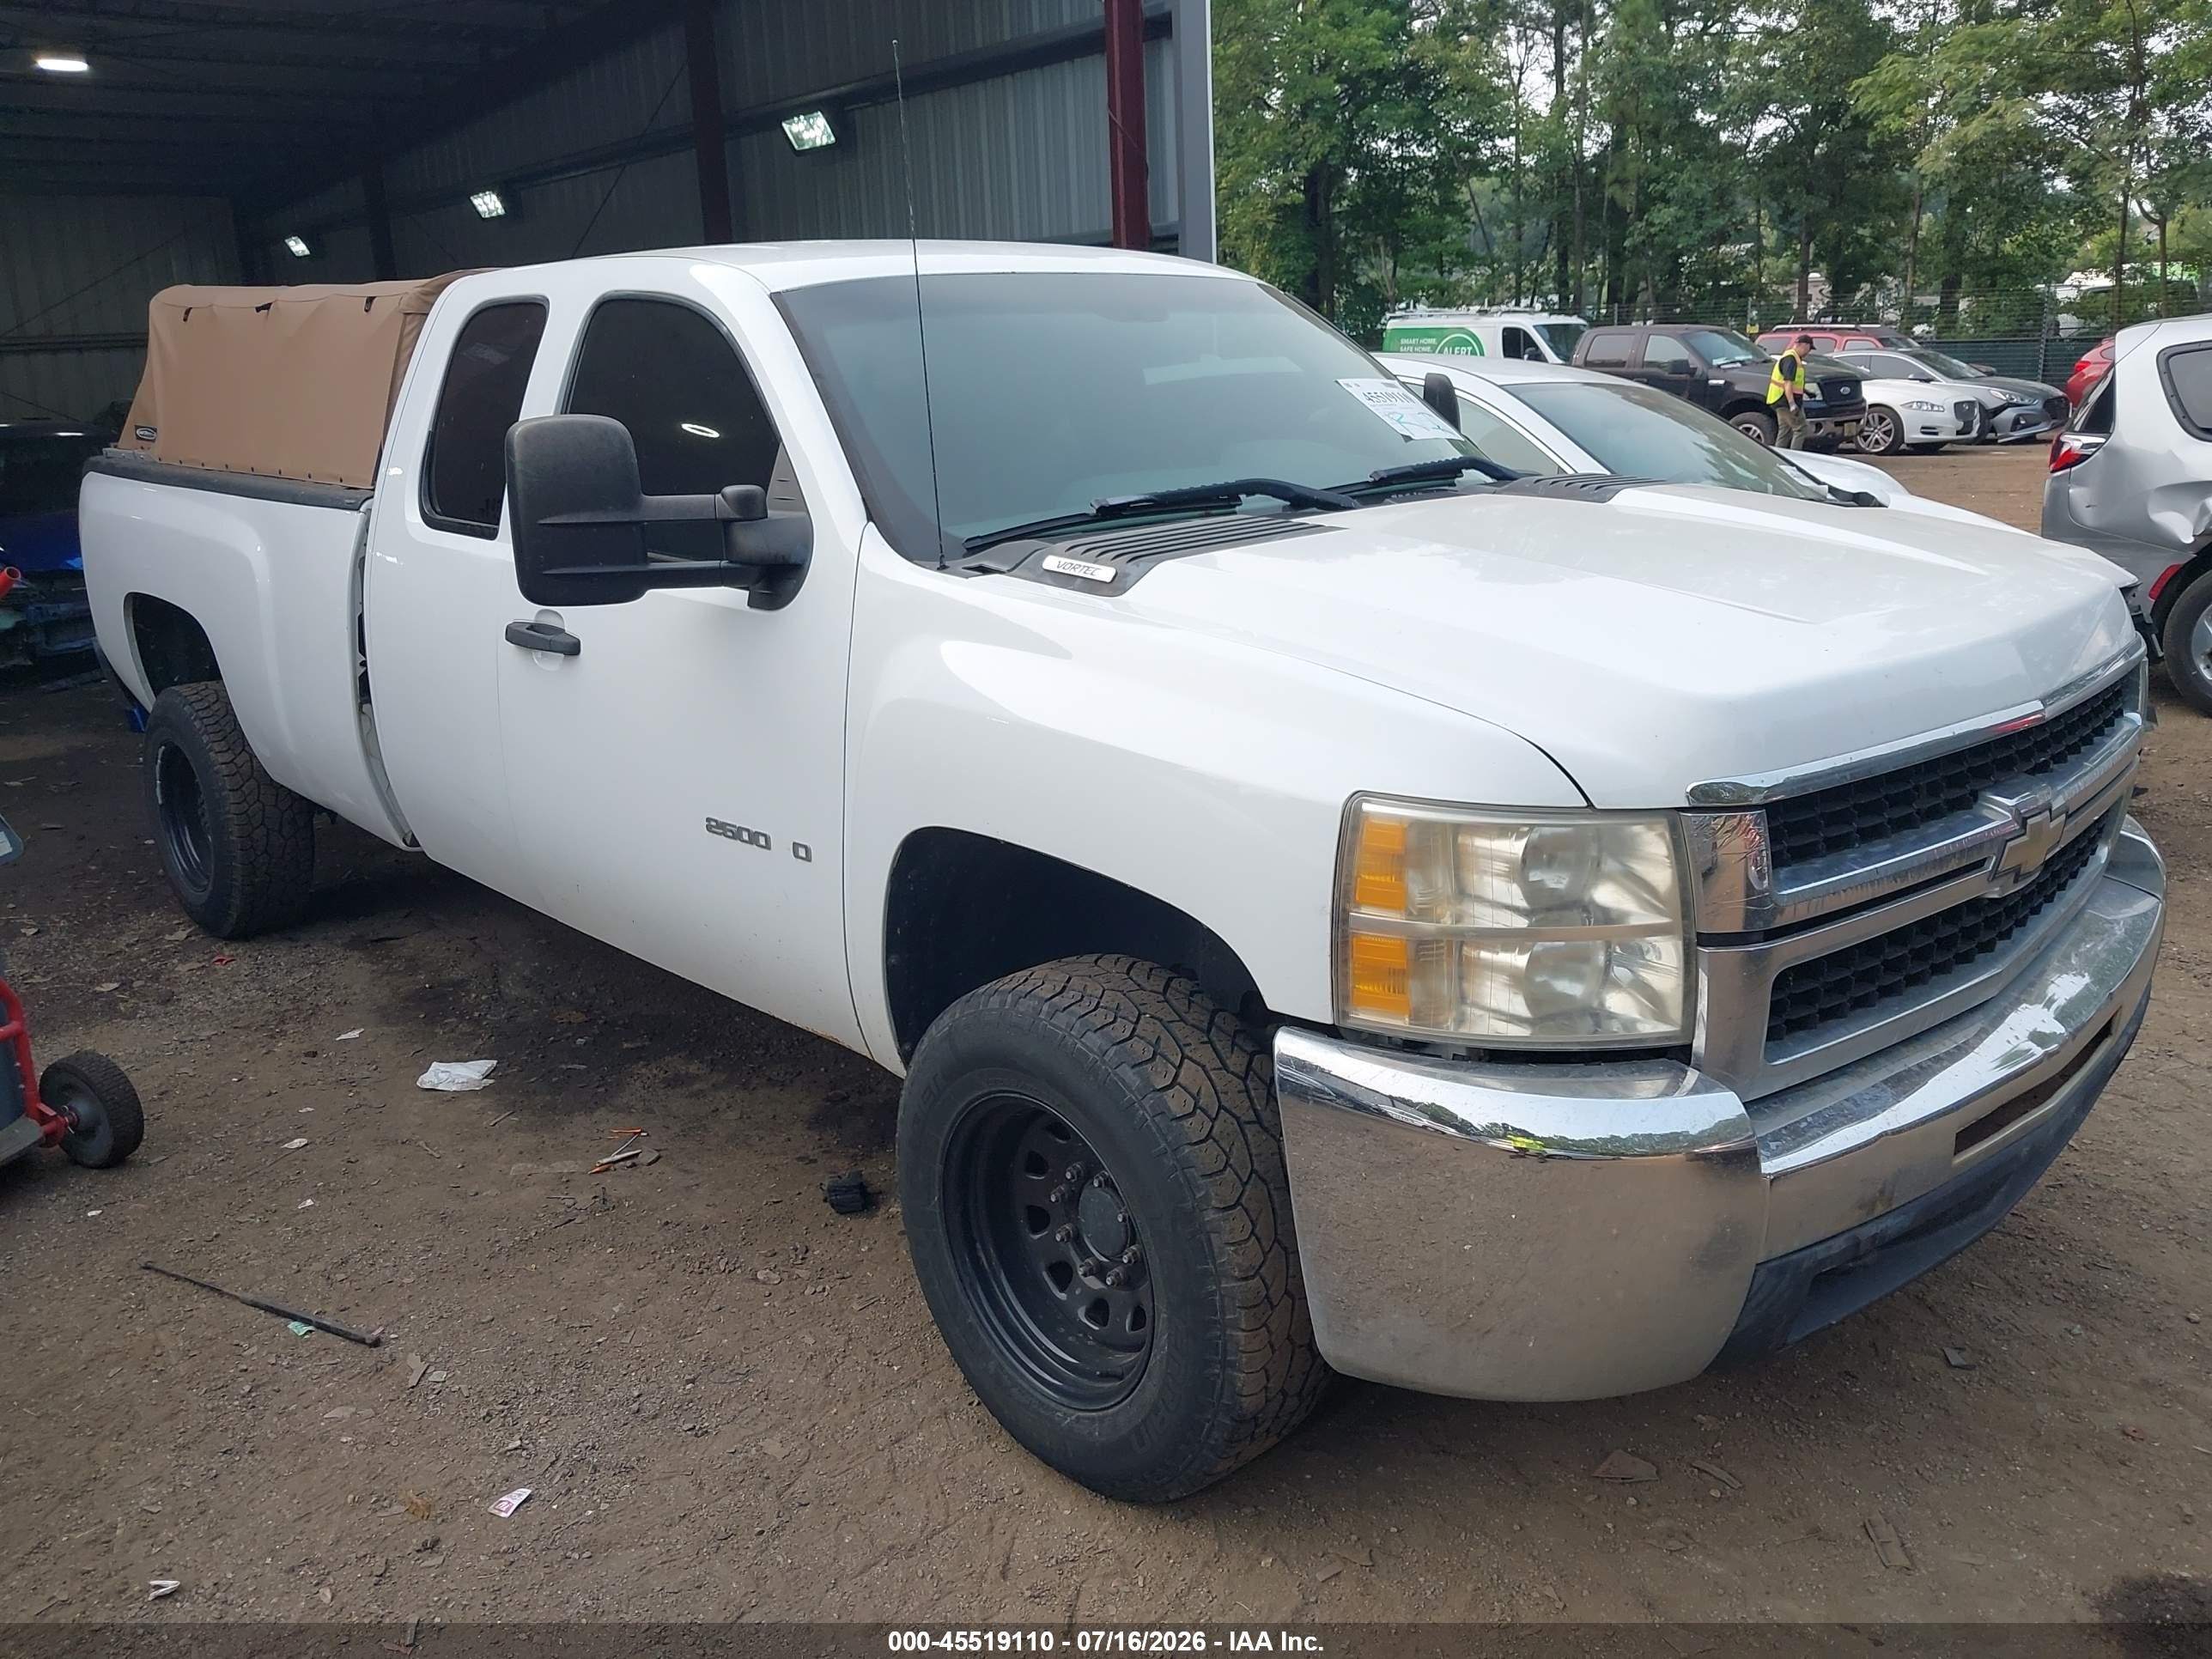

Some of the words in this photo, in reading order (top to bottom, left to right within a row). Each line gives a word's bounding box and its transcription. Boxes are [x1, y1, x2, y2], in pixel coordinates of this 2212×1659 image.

[1443, 347, 1473, 356] ALERT
[1056, 560, 1102, 576] VORTEC
[706, 817, 772, 851] 2500
